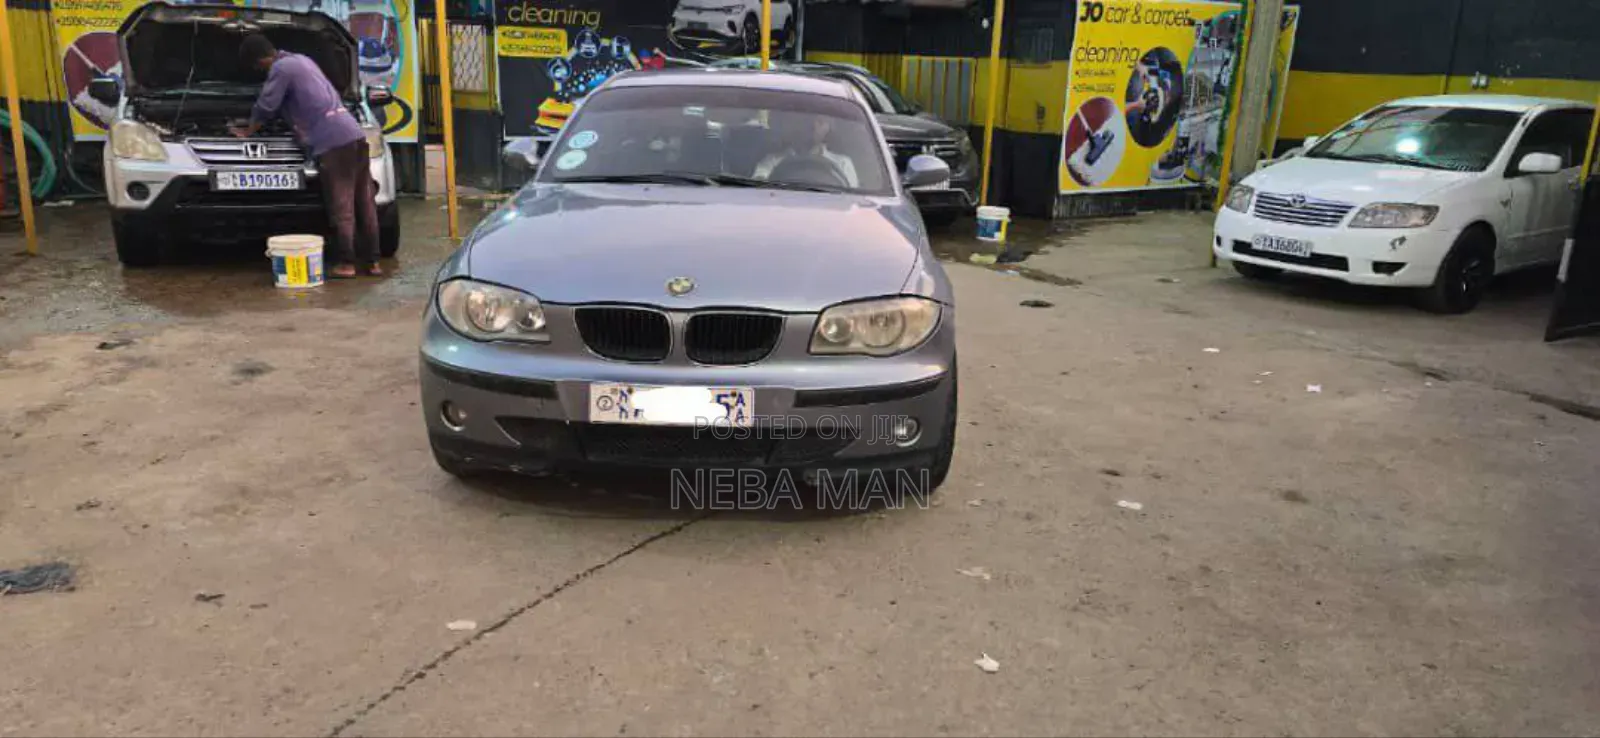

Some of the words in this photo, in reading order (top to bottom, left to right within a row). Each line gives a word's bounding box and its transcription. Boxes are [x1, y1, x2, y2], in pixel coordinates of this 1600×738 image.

[507, 1, 601, 30] cleaning
[1080, 1, 1103, 22] JO
[1105, 6, 1130, 24] car
[1132, 2, 1142, 24] &
[1145, 8, 1191, 29] carpet
[1075, 41, 1140, 68] cleaning
